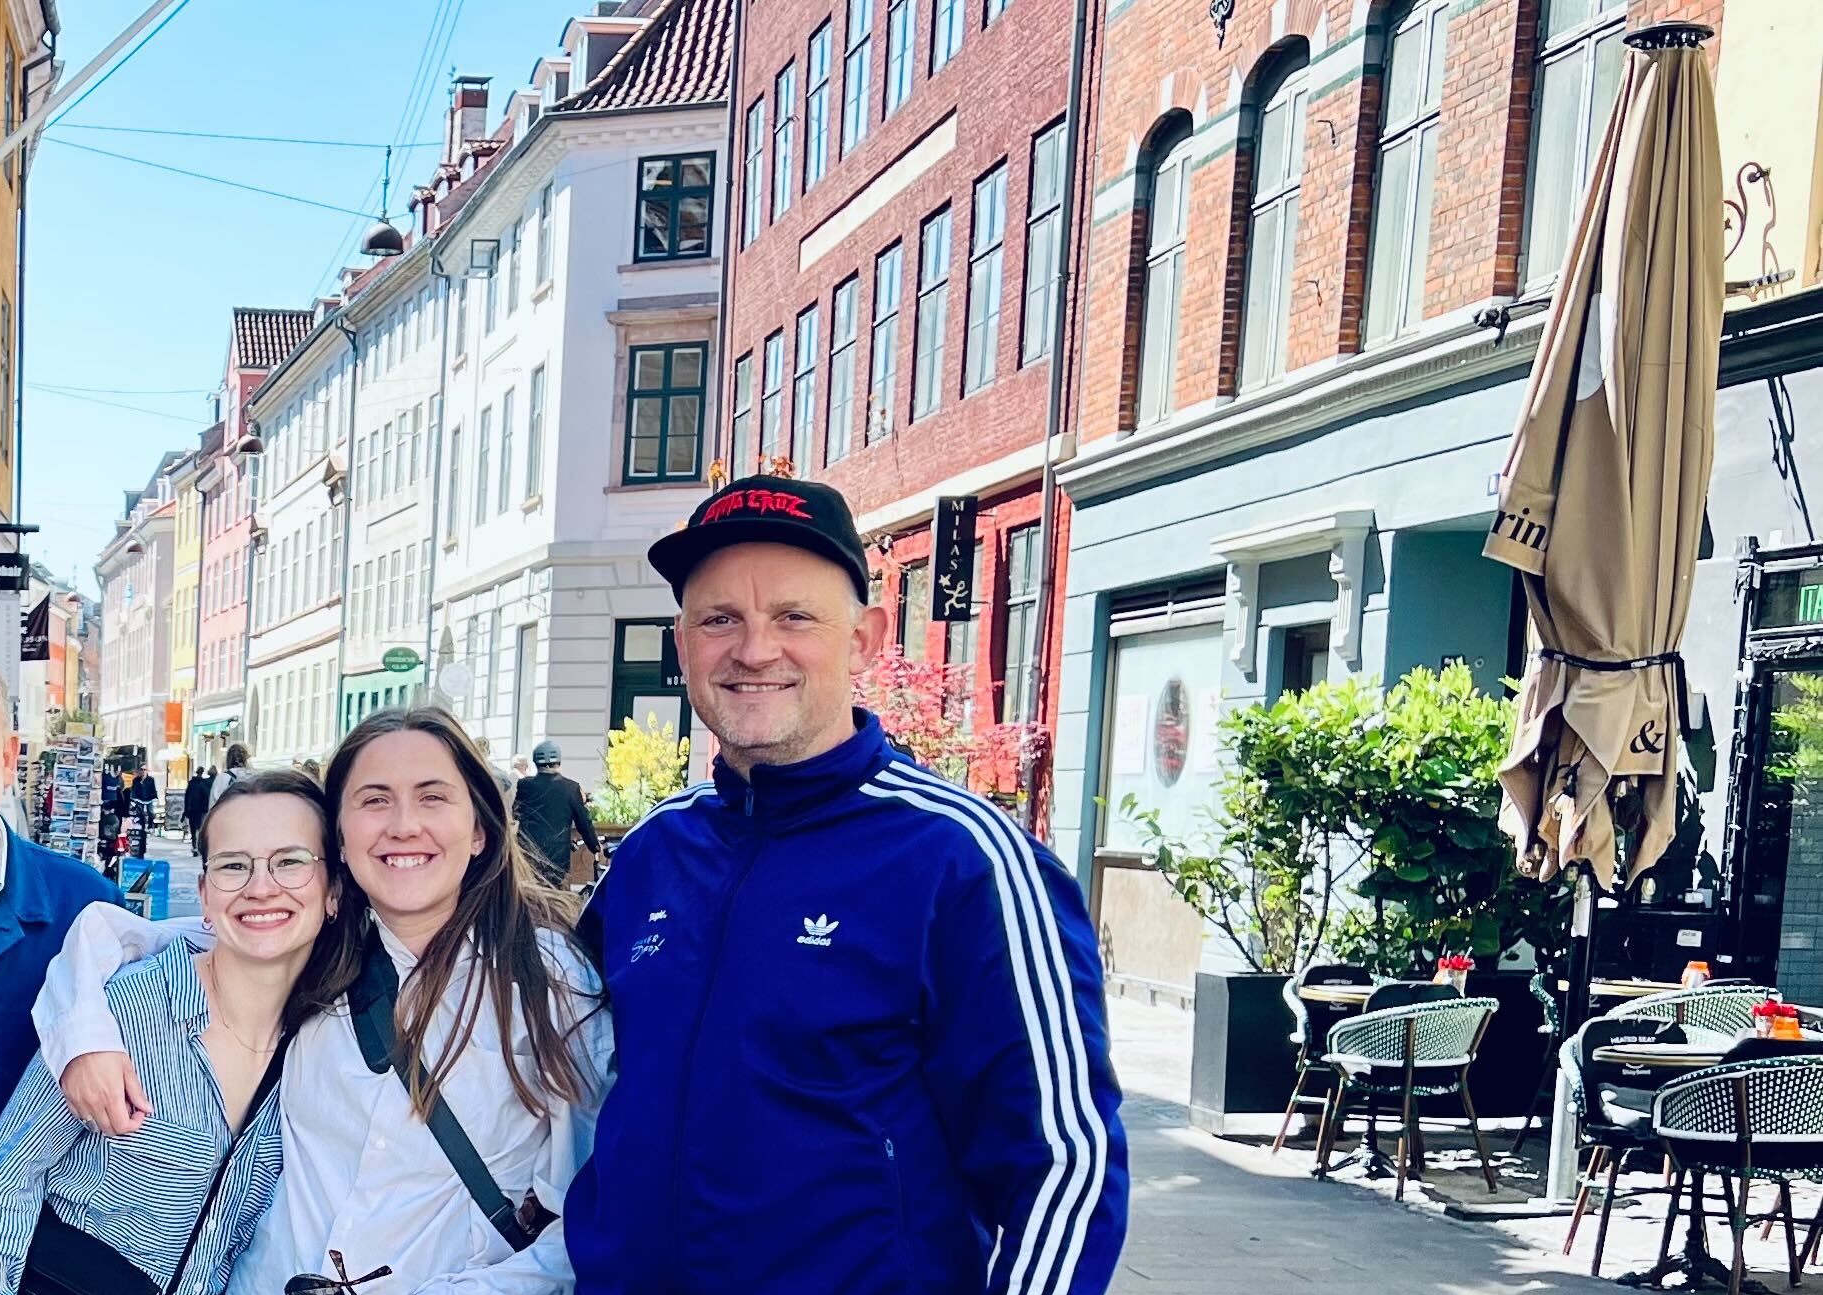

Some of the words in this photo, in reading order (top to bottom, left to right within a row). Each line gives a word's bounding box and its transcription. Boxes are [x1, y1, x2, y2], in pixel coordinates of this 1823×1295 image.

[951, 500, 965, 571] MILAS
[1630, 719, 1664, 754] &
[796, 935, 832, 946] adidas
